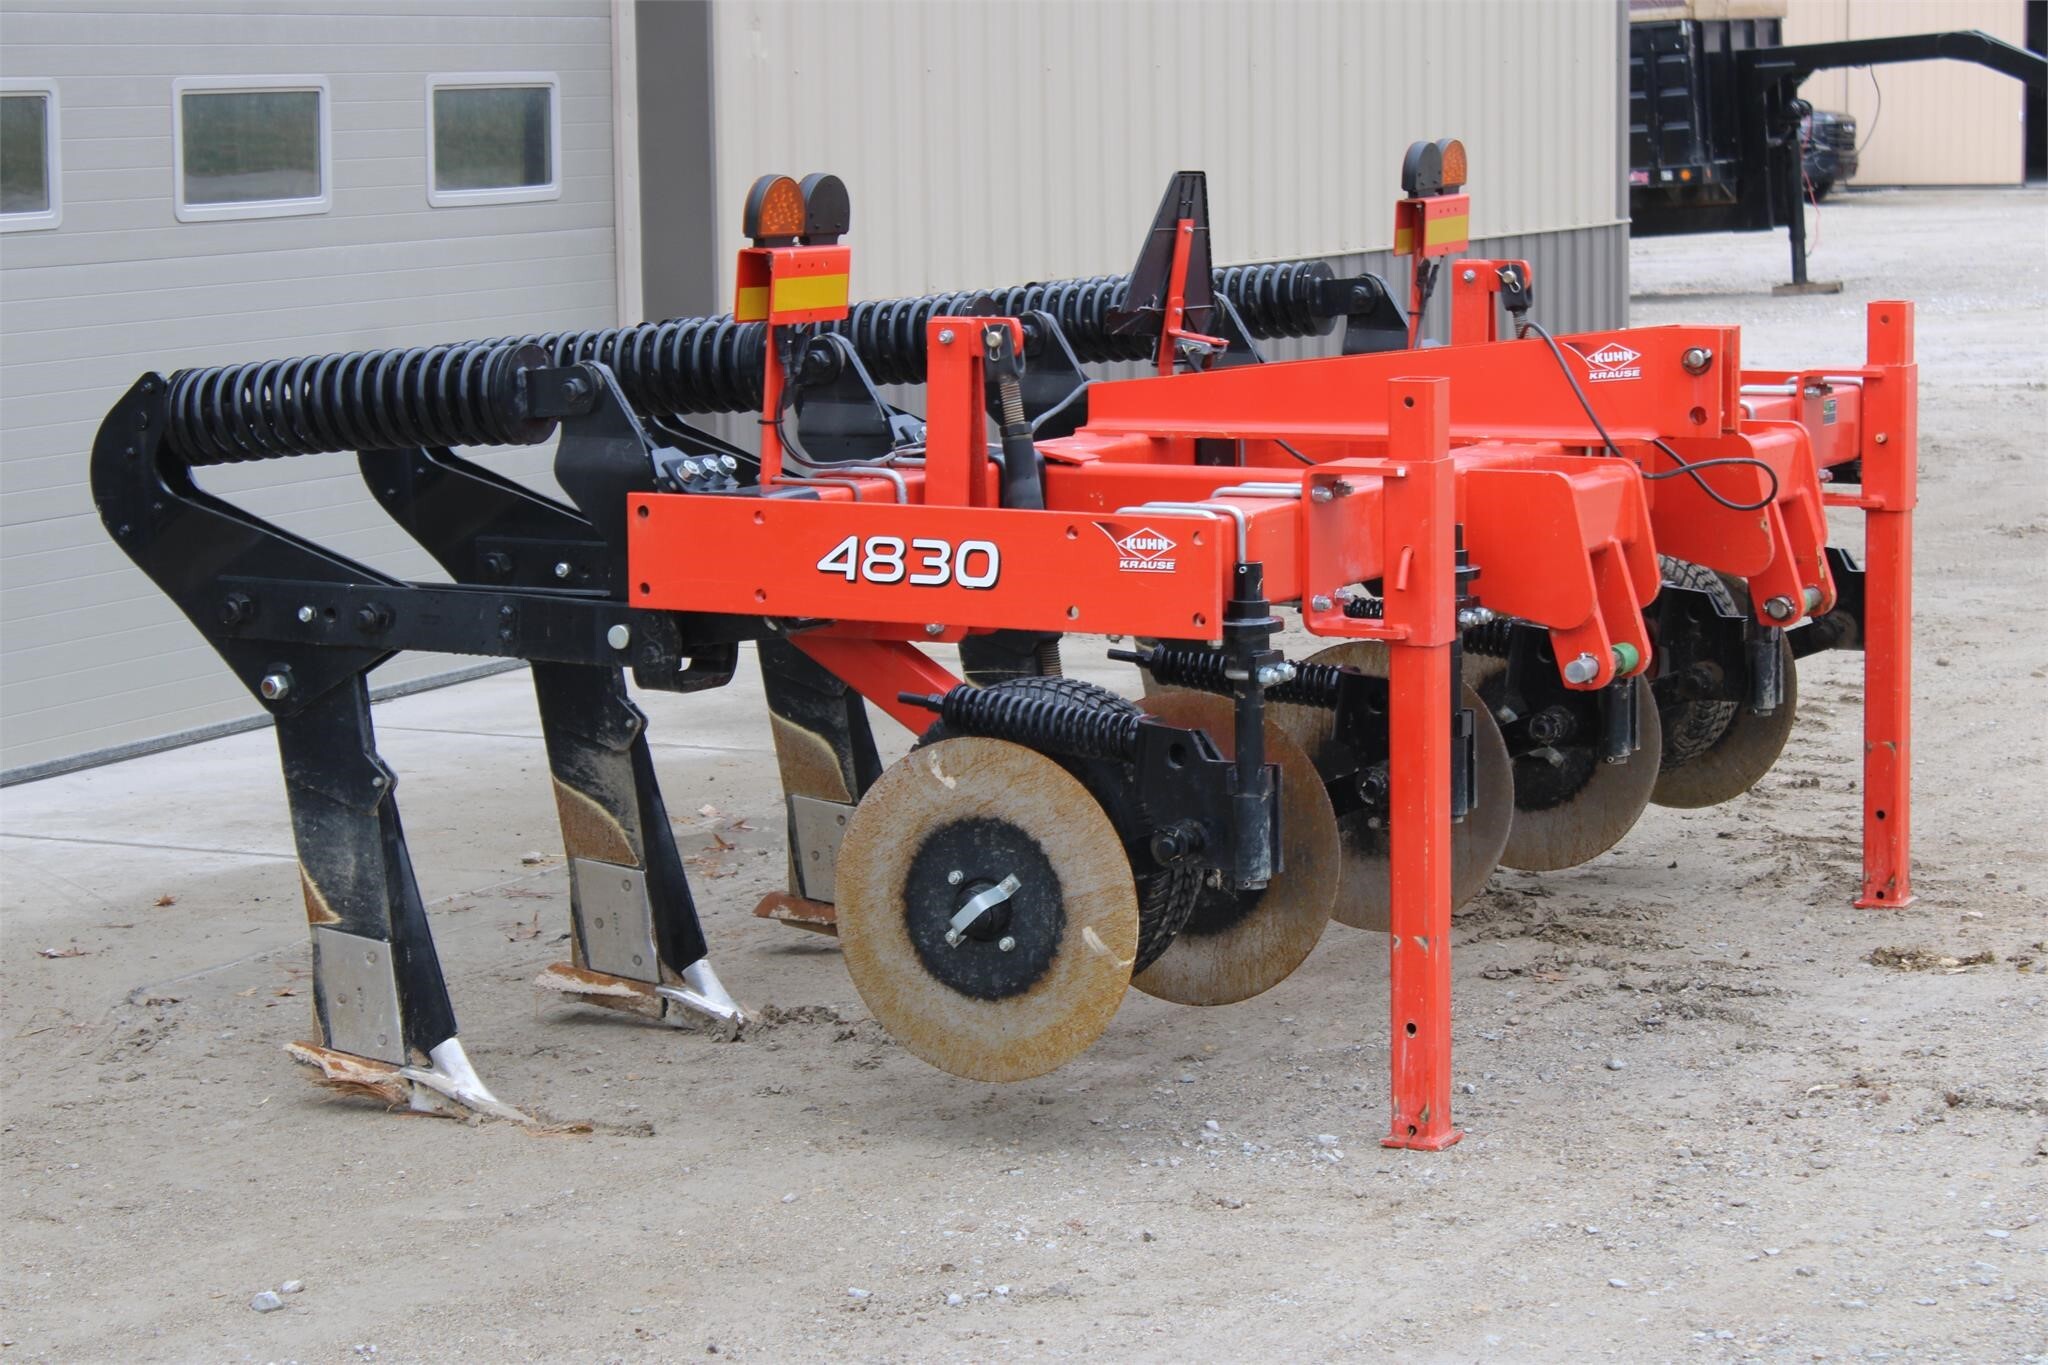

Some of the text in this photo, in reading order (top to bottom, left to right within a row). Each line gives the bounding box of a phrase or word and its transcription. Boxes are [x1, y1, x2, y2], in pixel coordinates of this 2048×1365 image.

[1594, 351, 1633, 363] KUHN
[1588, 369, 1640, 380] KRAUSE
[1126, 537, 1168, 550] KUHN
[816, 535, 1000, 589] 4830
[1119, 560, 1175, 570] KRAUSE
